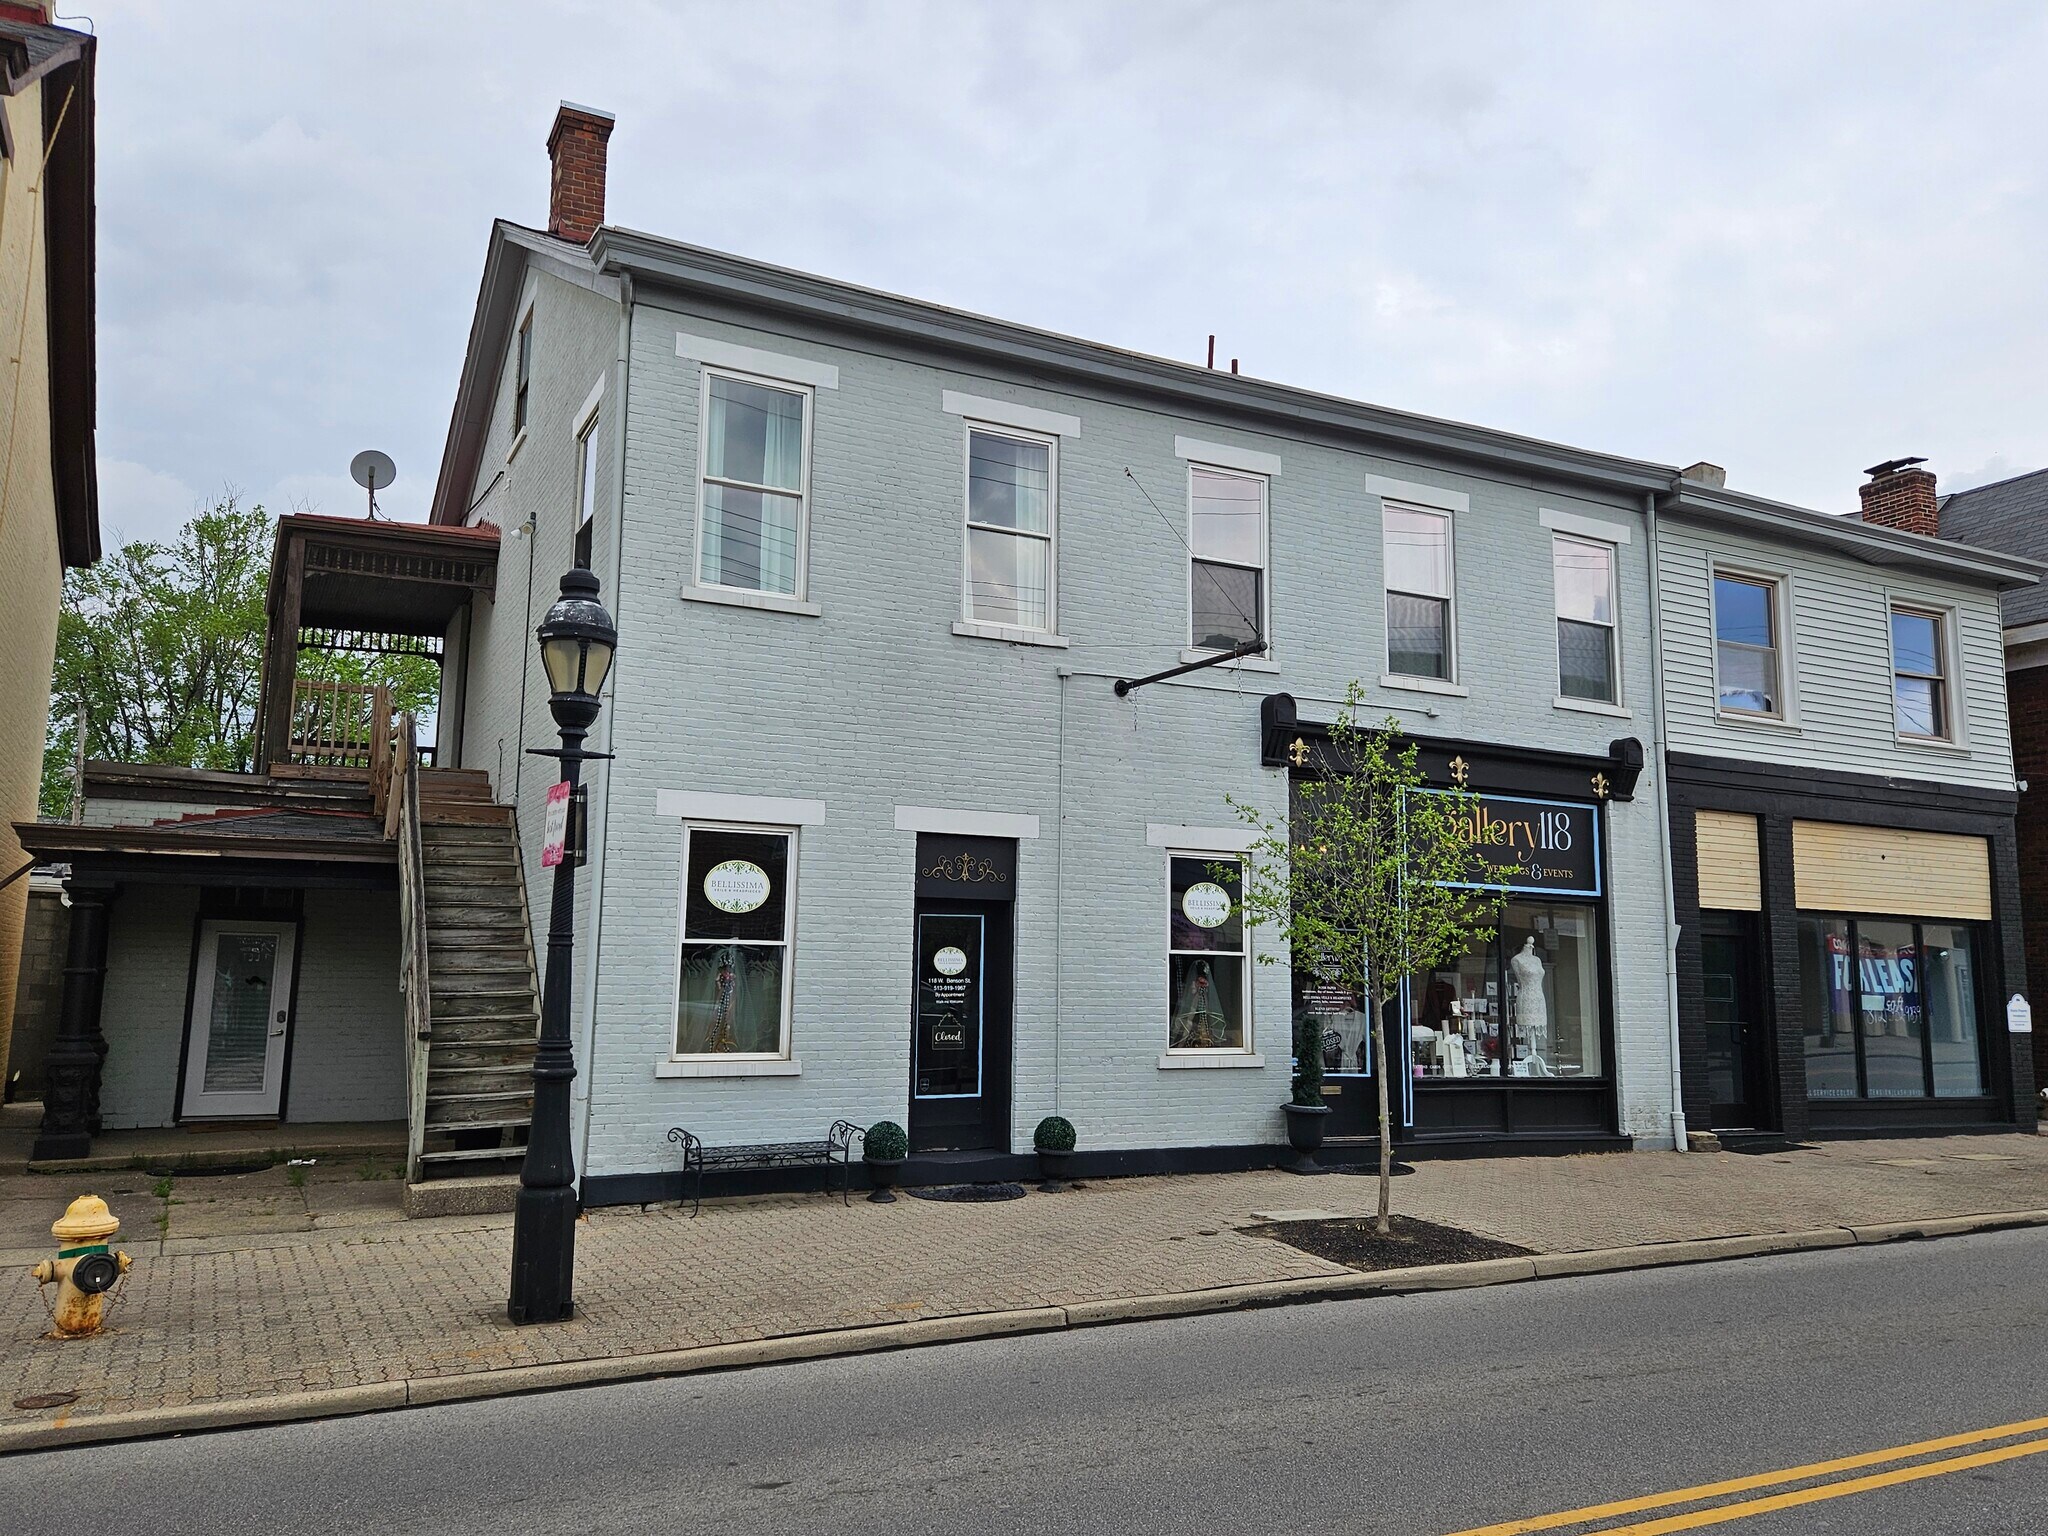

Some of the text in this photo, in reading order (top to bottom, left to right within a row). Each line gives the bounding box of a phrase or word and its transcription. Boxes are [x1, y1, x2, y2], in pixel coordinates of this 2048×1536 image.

[1531, 863, 1542, 880] &
[1543, 867, 1574, 879] EVENTS
[711, 880, 764, 889] BELLISSIMA
[935, 1030, 962, 1042] Closed
[1321, 1035, 1341, 1049] LOSED
